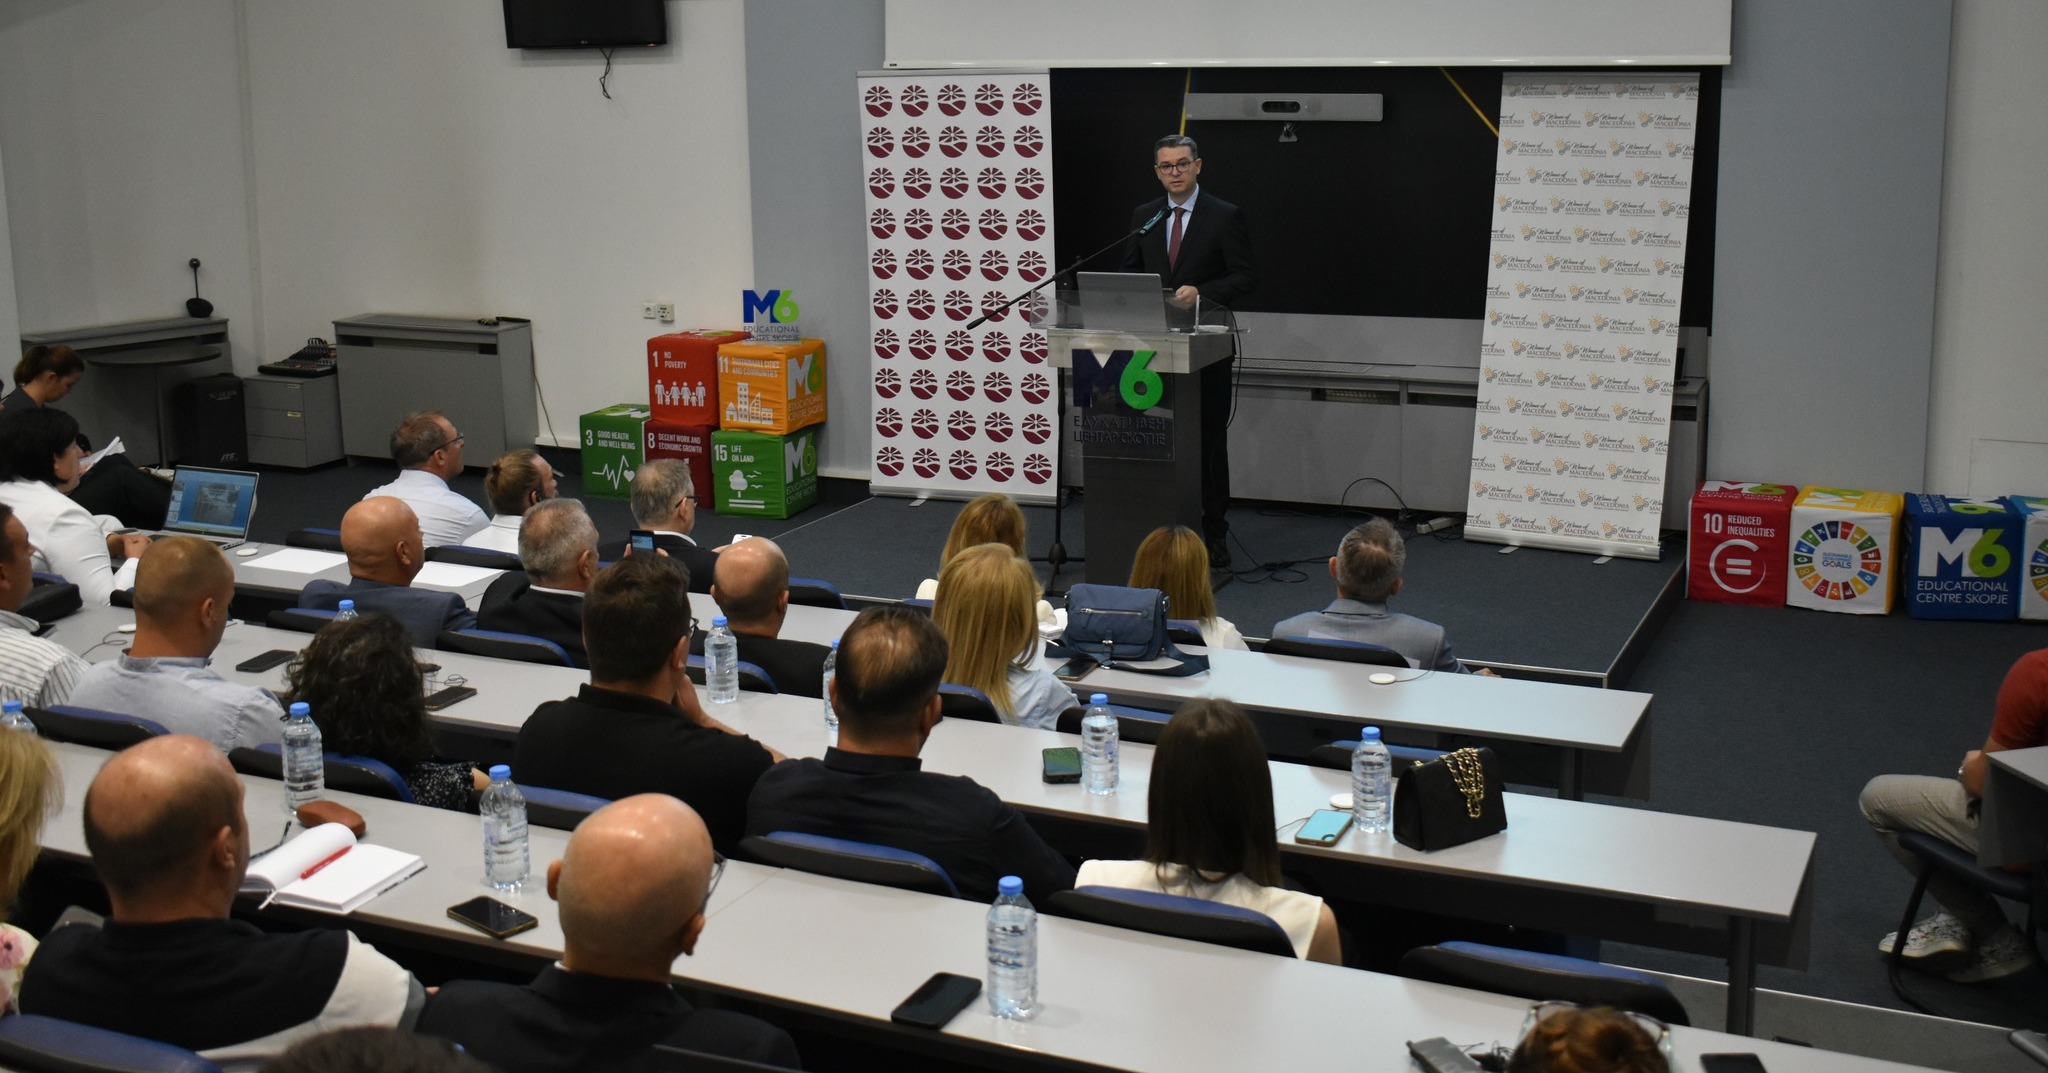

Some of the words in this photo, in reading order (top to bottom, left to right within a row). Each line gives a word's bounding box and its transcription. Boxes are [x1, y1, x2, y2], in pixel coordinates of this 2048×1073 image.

[743, 289, 800, 323] M6
[743, 325, 800, 333] EDUCATIONAL
[652, 351, 659, 368] 1
[663, 351, 672, 359] NO
[664, 361, 687, 369] POVERTY
[732, 367, 743, 375] AND
[787, 351, 823, 400] M6
[1071, 348, 1164, 410] M6
[585, 429, 594, 446] 3
[597, 430, 611, 439] GOOD
[611, 431, 630, 440] HEALTH
[648, 432, 656, 449] 8
[658, 433, 676, 442] DECENT
[676, 434, 691, 443] WORK
[691, 436, 701, 445] AND
[1074, 430, 1118, 444] ЦЕНТАР
[598, 439, 608, 448] AND
[682, 444, 703, 454] GROWTH
[714, 444, 728, 462] 15
[731, 445, 742, 453] LIFE
[731, 454, 740, 462] ON
[740, 455, 755, 463] LAND
[784, 432, 816, 484] M6
[1623, 473, 1659, 481] MACEDONIA
[1540, 496, 1575, 504] MACEDONIA
[1512, 522, 1546, 530] MACEDONIA
[1703, 513, 1723, 534] 10
[1727, 515, 1762, 526] REDUCED
[1564, 527, 1599, 535] MACEDONIA
[1618, 532, 1654, 540] MACEDONIA
[1727, 525, 1775, 538] INEQUALITIES
[1918, 526, 2011, 578] M6
[1822, 560, 1852, 569] GOALS
[1917, 580, 2009, 592] EDUCATIONAL
[1916, 592, 1961, 604] CENTRE
[1965, 593, 2009, 605] SKOPJE
